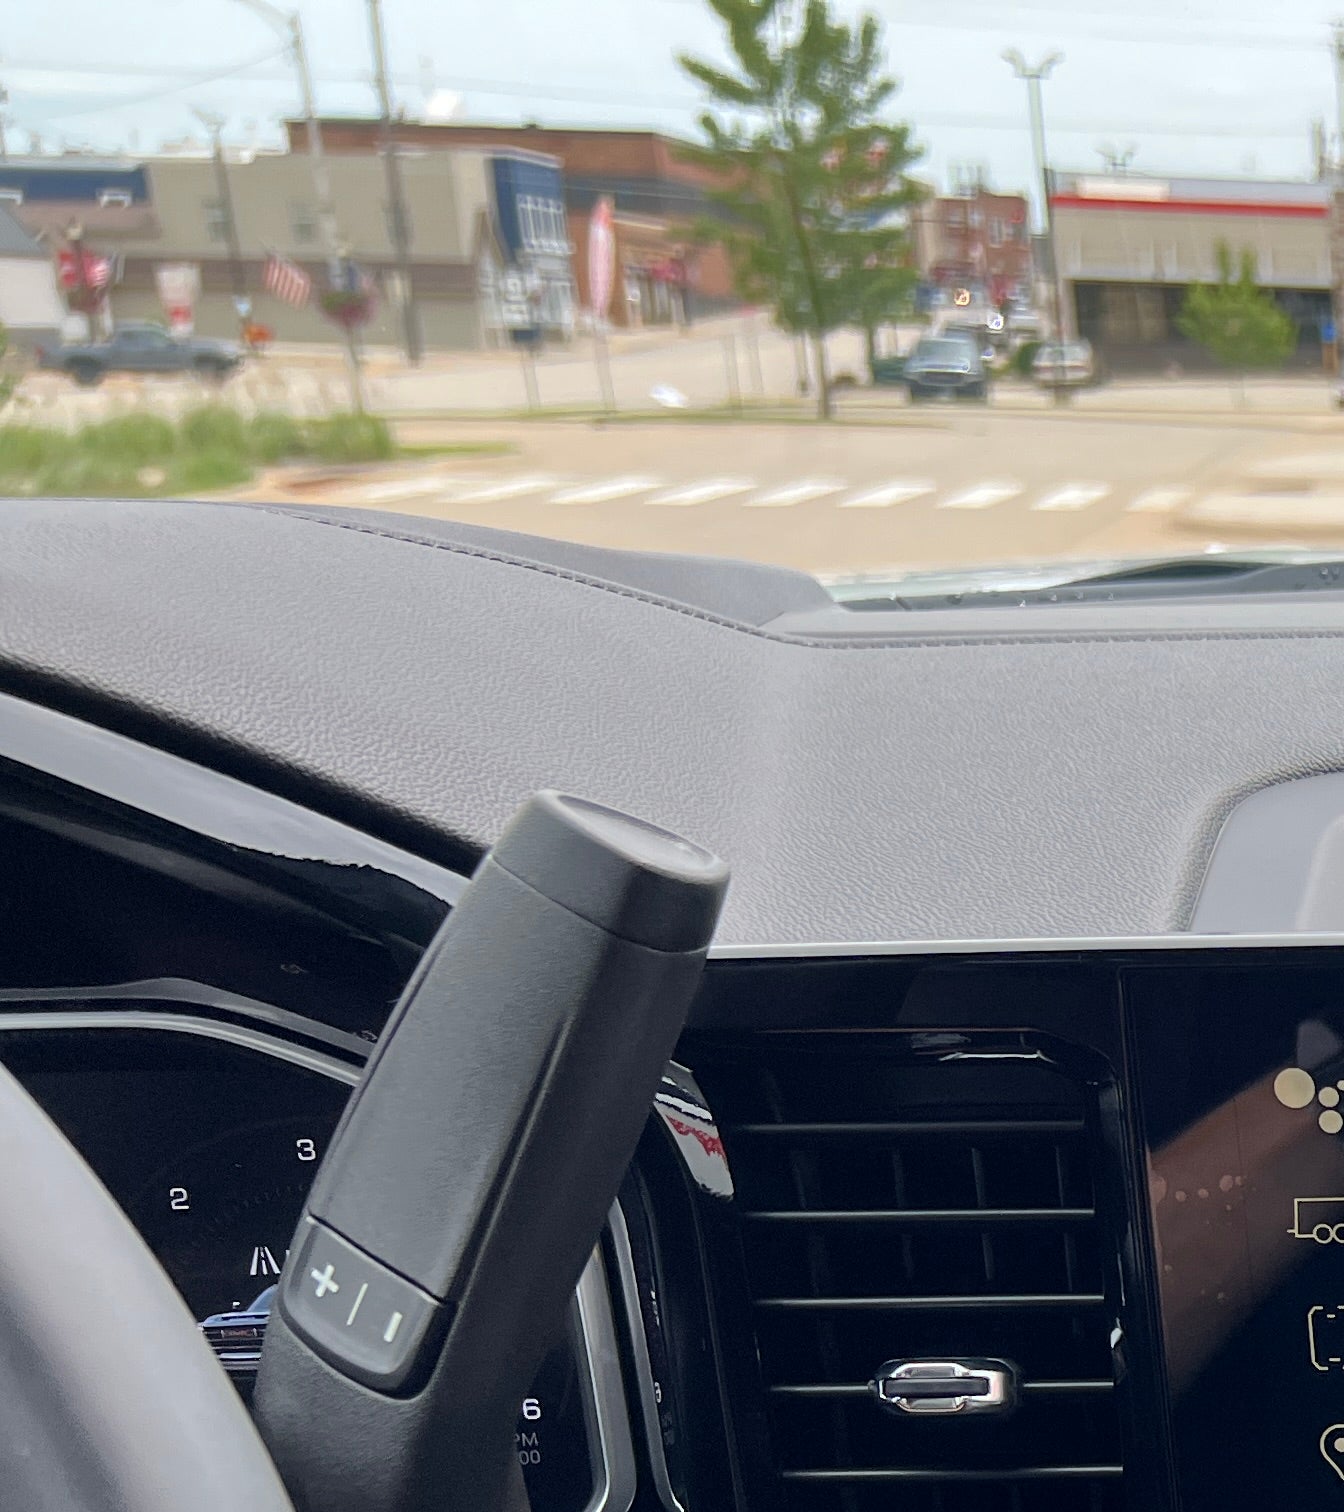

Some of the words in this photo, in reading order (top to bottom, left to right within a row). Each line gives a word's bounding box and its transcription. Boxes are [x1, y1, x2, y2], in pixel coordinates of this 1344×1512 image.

[297, 1139, 316, 1161] 3
[170, 1187, 190, 1210] 2
[522, 1398, 542, 1420] 6
